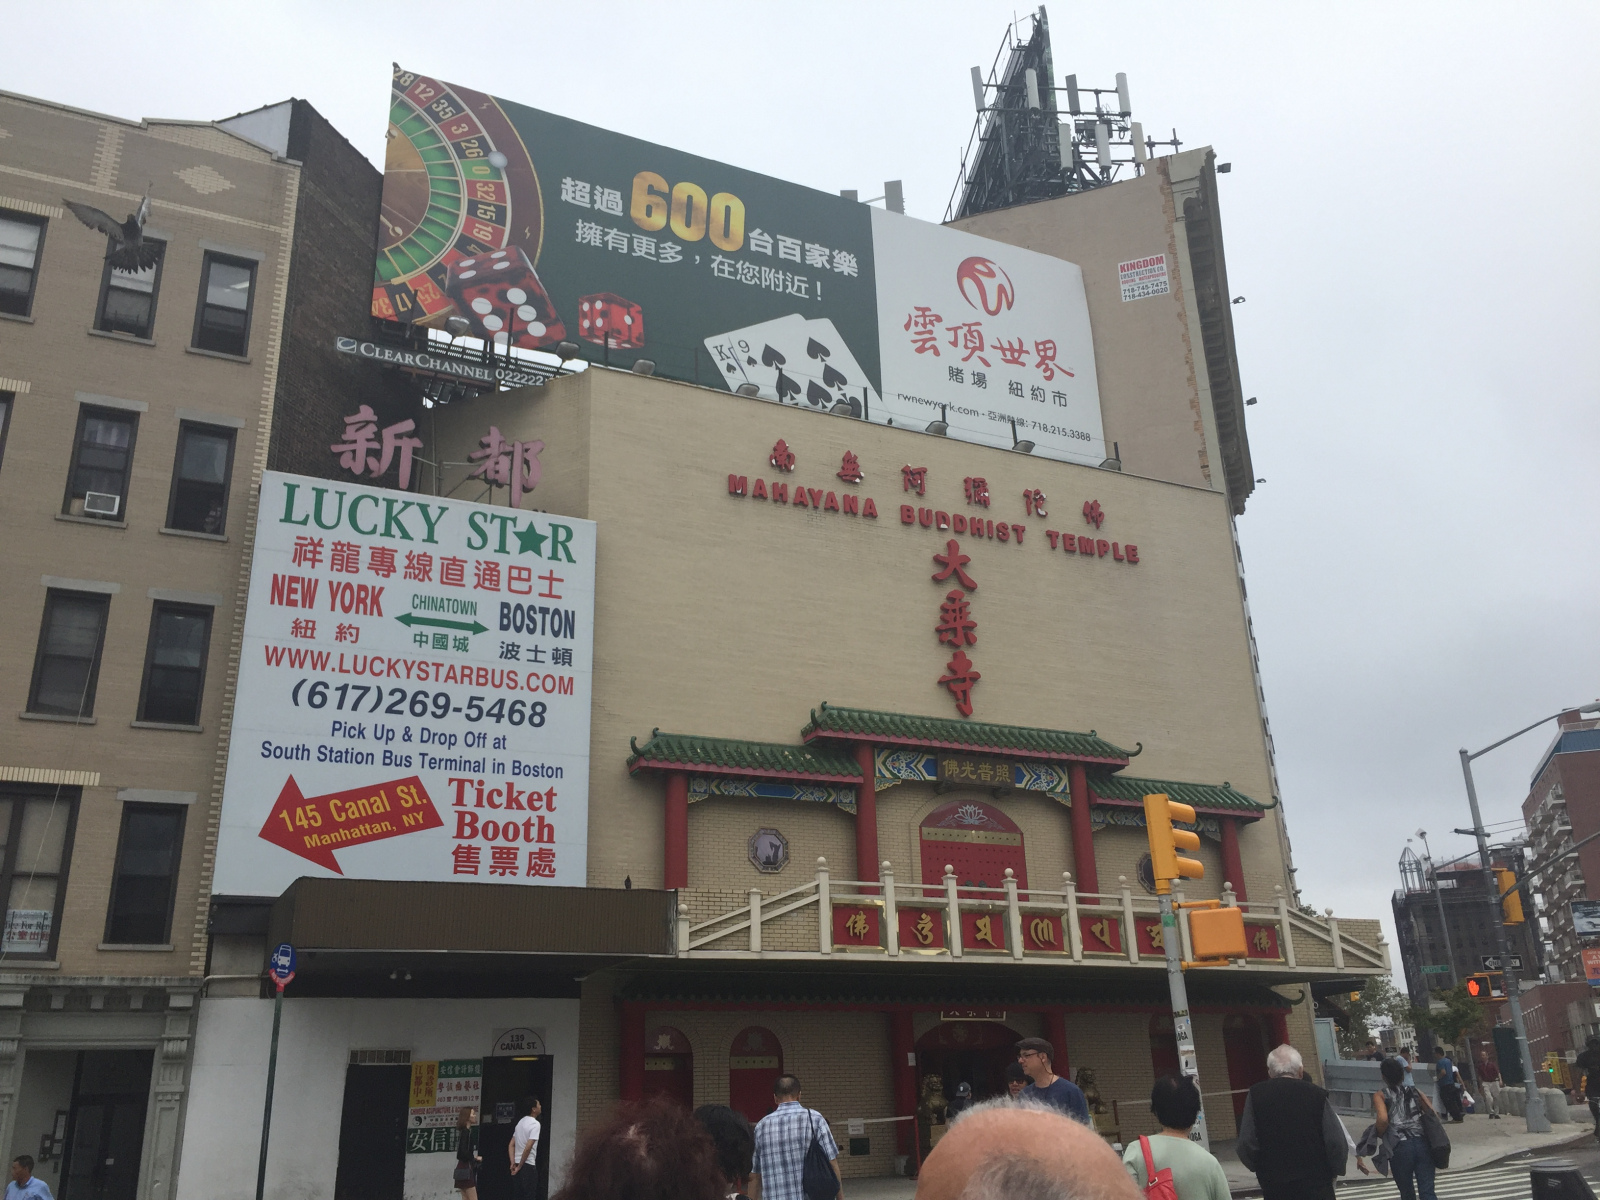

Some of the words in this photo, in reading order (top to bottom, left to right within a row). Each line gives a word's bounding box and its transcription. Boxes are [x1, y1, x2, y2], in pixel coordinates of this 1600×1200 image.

[414, 82, 435, 101] 12
[431, 99, 456, 120] 35
[461, 140, 483, 158] 26
[476, 182, 495, 200] 32
[476, 203, 496, 221] 15
[561, 176, 624, 217] 超過
[630, 171, 746, 252] 600
[748, 228, 859, 278] 台百家樂
[472, 223, 493, 241] 19
[1120, 256, 1164, 273] KINGDOM
[713, 344, 731, 362] K
[737, 339, 751, 354] 9
[904, 306, 1075, 381] 雲頂世界
[495, 368, 544, 386] 022222
[948, 366, 988, 389] 賭場
[1008, 380, 1068, 408] 紐約市
[897, 393, 979, 418] rwnewyork.com
[1031, 421, 1091, 442] 718.215.3388
[279, 482, 449, 545] LUCKY
[728, 474, 879, 519] MAHAYANA
[900, 505, 1026, 543] BUDDHIST
[1045, 529, 1140, 564] TEMPLE
[291, 535, 565, 600] 祥龍專線直通巴士
[270, 573, 318, 610] NEW
[329, 580, 385, 617] YORK
[411, 593, 478, 617] CHINATOWN
[291, 618, 360, 644] 紐約
[499, 601, 576, 639] BOSTON
[931, 539, 981, 717] 大乘寺
[412, 631, 470, 653] 中國城
[499, 641, 573, 667] 波士頓
[264, 645, 575, 696] WWW.LUCKYSTARBUS.COM
[291, 678, 548, 728] (617)269-5468
[331, 720, 367, 740] Pick
[373, 725, 395, 746] Up
[402, 726, 413, 742] &
[420, 728, 457, 750] Drop
[464, 731, 487, 749] Off
[493, 734, 507, 750] at
[260, 741, 310, 762] South
[317, 745, 375, 766] Station
[382, 749, 413, 769] Bus
[419, 752, 486, 775] Terminal
[492, 757, 506, 775] in
[511, 760, 564, 780] Boston
[942, 759, 1012, 783] 佛光普照
[279, 804, 322, 833] 145
[330, 789, 391, 823] Canal
[400, 783, 428, 808] St.
[448, 777, 558, 812] Ticket
[303, 819, 397, 850] Manhattan,
[402, 811, 425, 828] NY
[453, 810, 556, 844] Booth
[451, 844, 557, 878] 售票處
[510, 1034, 525, 1042] 139
[408, 1128, 448, 1152] 安信
